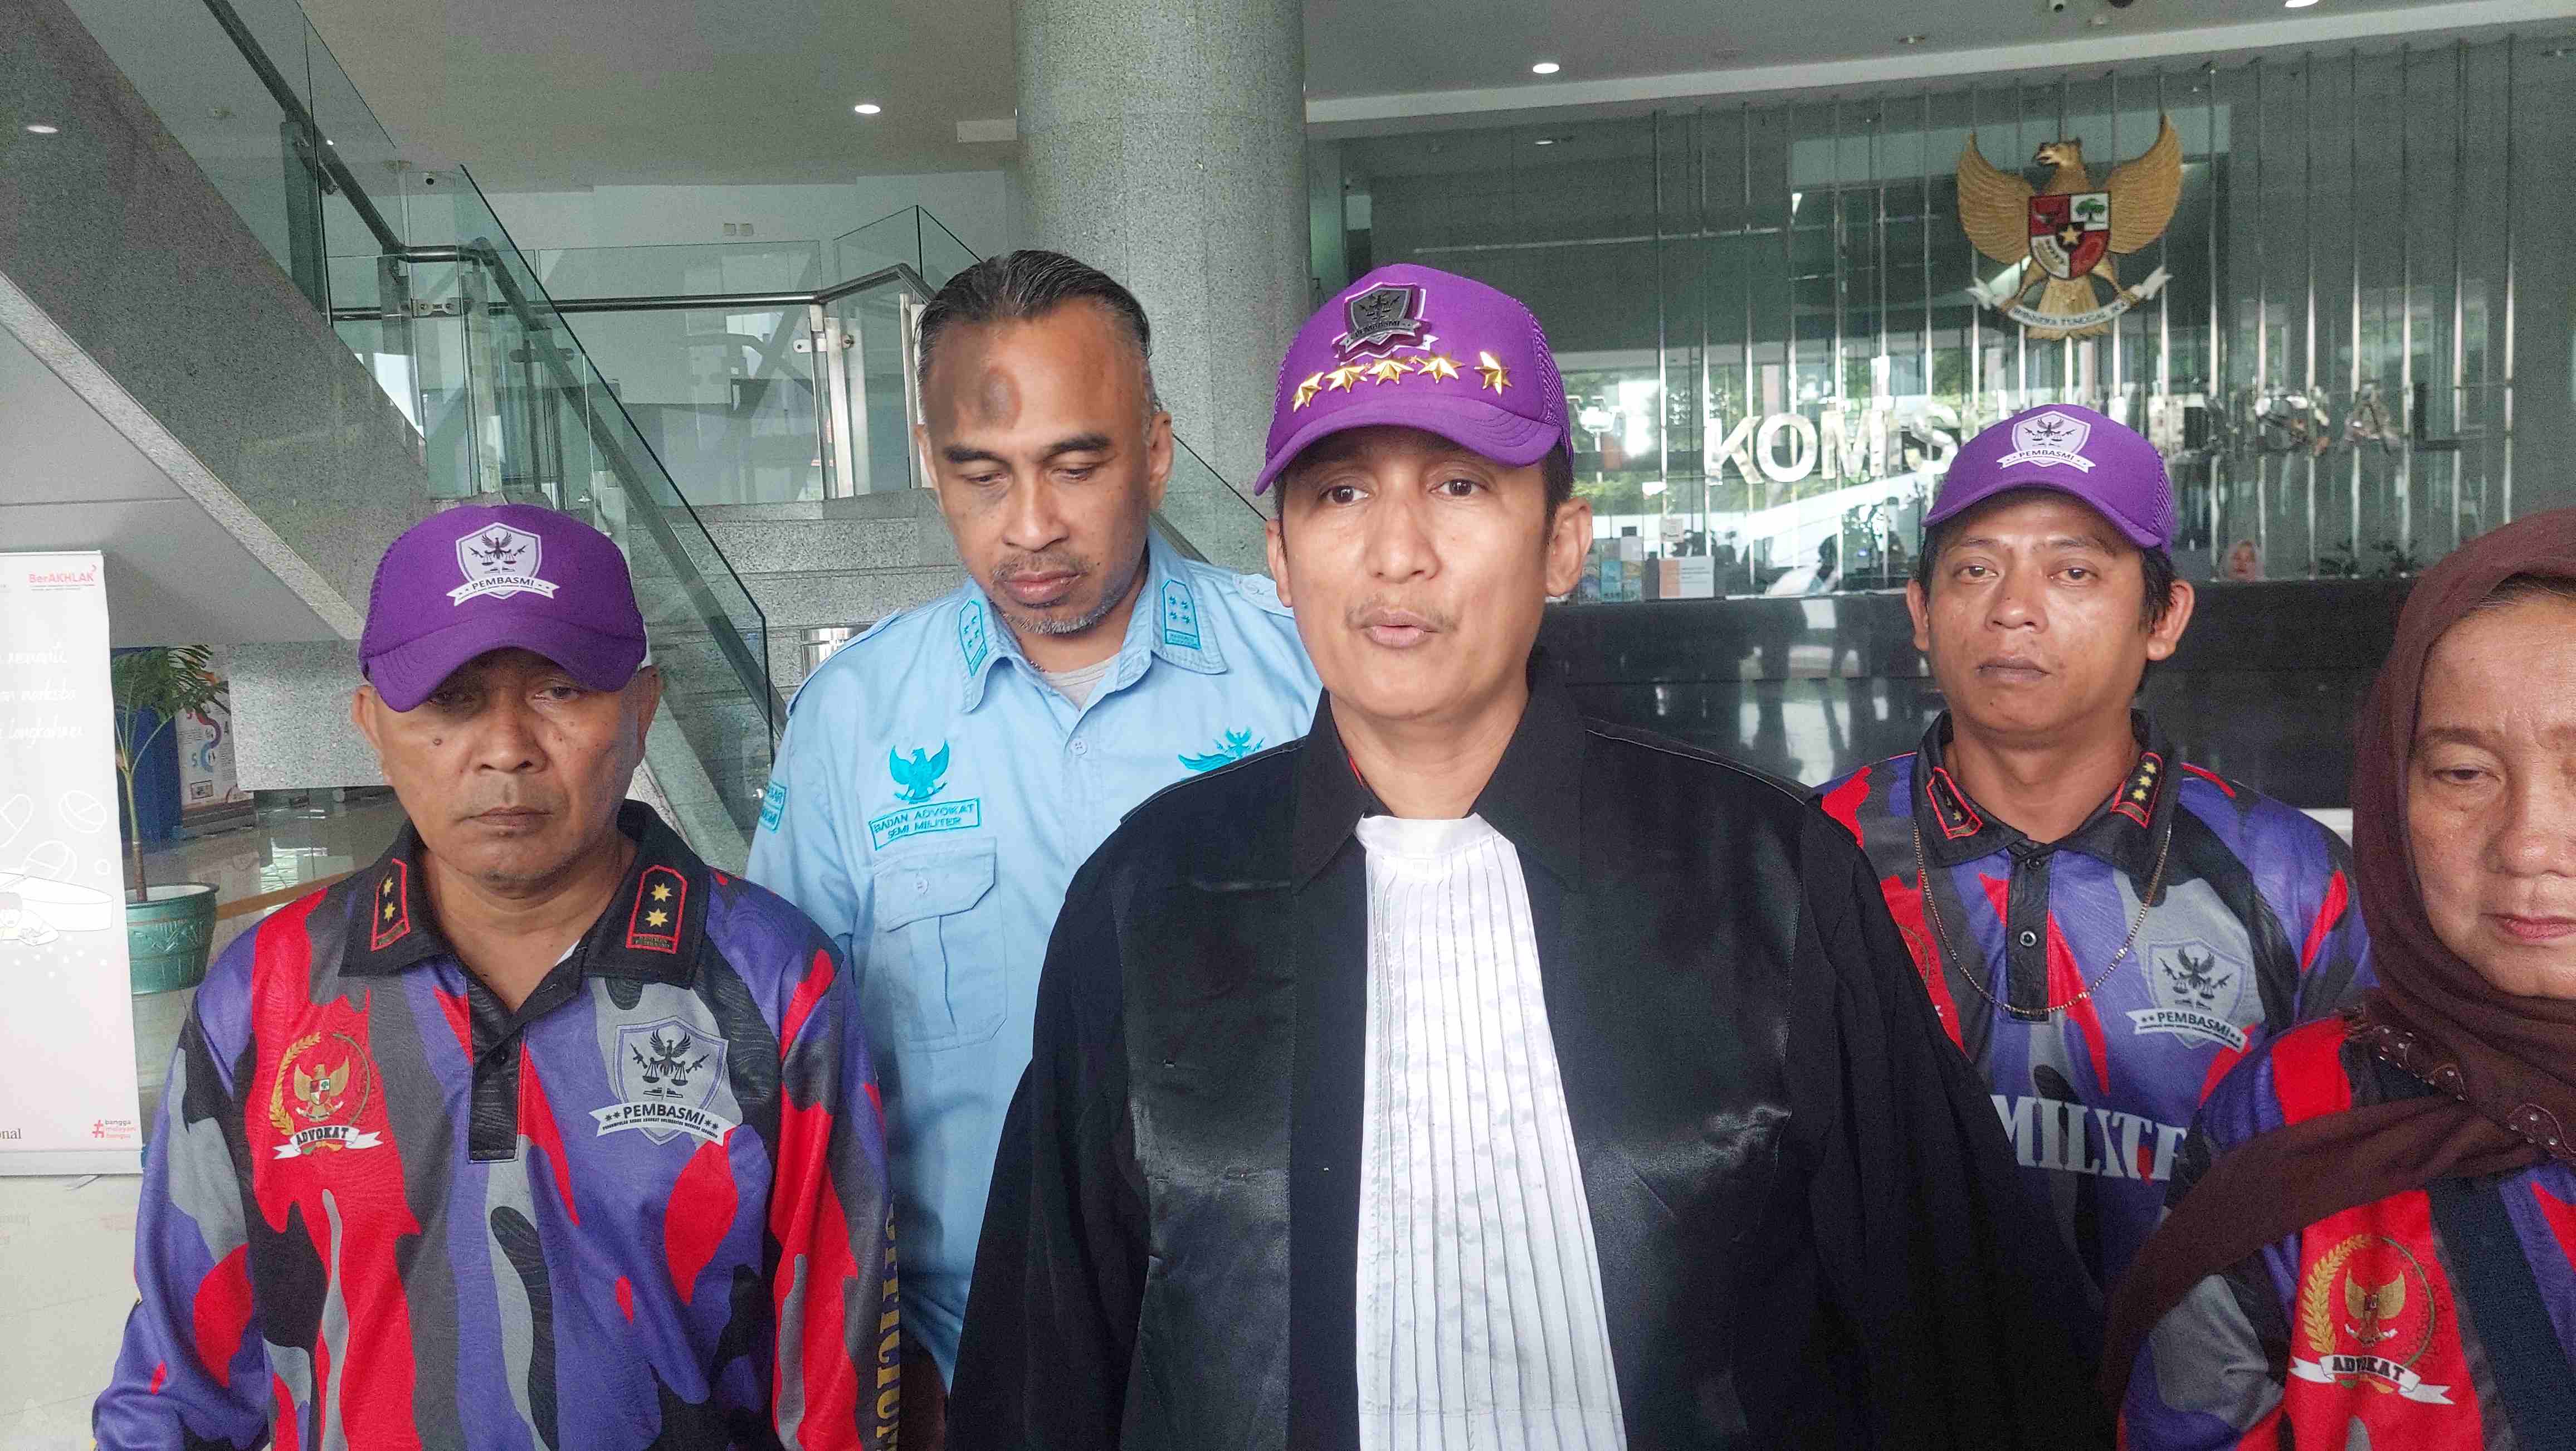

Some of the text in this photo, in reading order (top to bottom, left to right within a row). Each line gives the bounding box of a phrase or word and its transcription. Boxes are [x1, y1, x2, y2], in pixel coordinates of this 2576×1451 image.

[2019, 450, 2075, 460] PEMBASMI
[472, 577, 535, 590] PEMBASMI
[874, 804, 974, 834] BADAN ADVOKAT
[888, 817, 961, 839] SEMI MILITER
[2157, 1011, 2231, 1036] PEMBASMI
[623, 1103, 705, 1126] PEMBASMI
[296, 1126, 349, 1146] ADVOKAT
